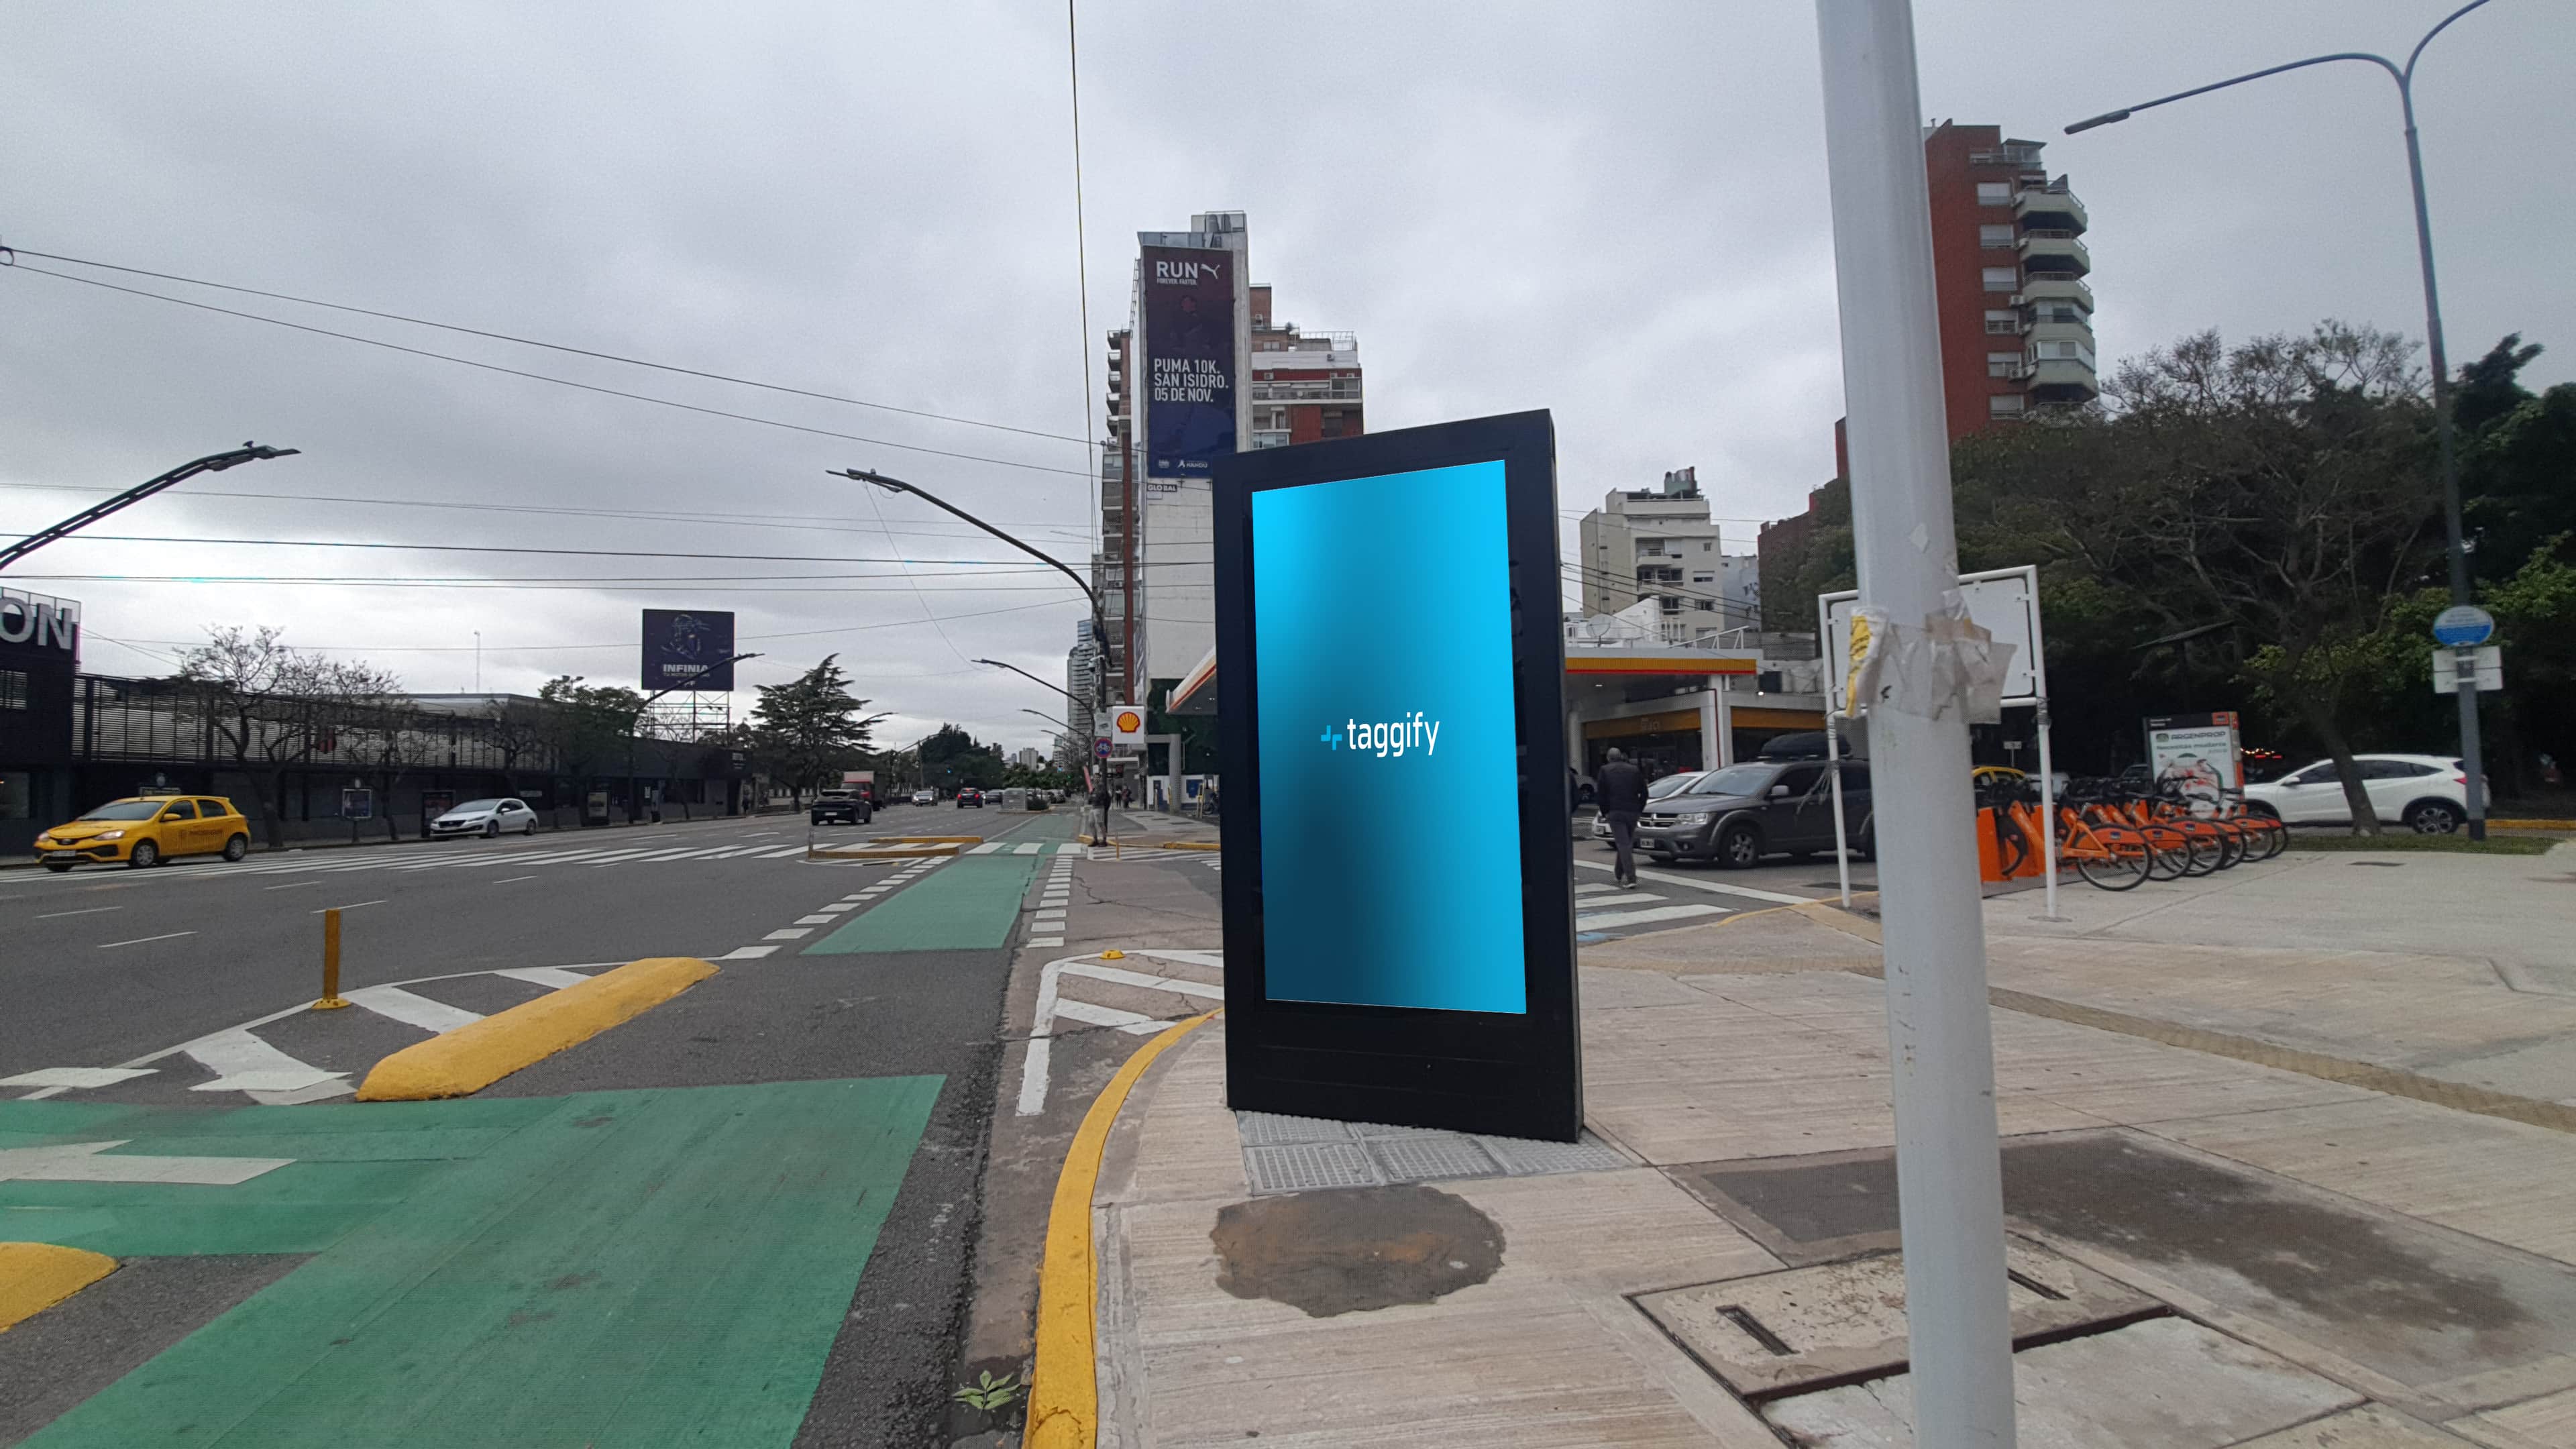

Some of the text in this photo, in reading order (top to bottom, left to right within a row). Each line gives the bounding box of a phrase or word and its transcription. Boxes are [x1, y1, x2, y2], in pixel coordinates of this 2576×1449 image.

[1157, 261, 1198, 278] RUN
[1154, 358, 1220, 374] PUMA 10K.
[1154, 373, 1228, 388] SAN ISIDRO.
[1155, 387, 1213, 402] 05 DE NOV.
[1347, 712, 1440, 757] taggify
